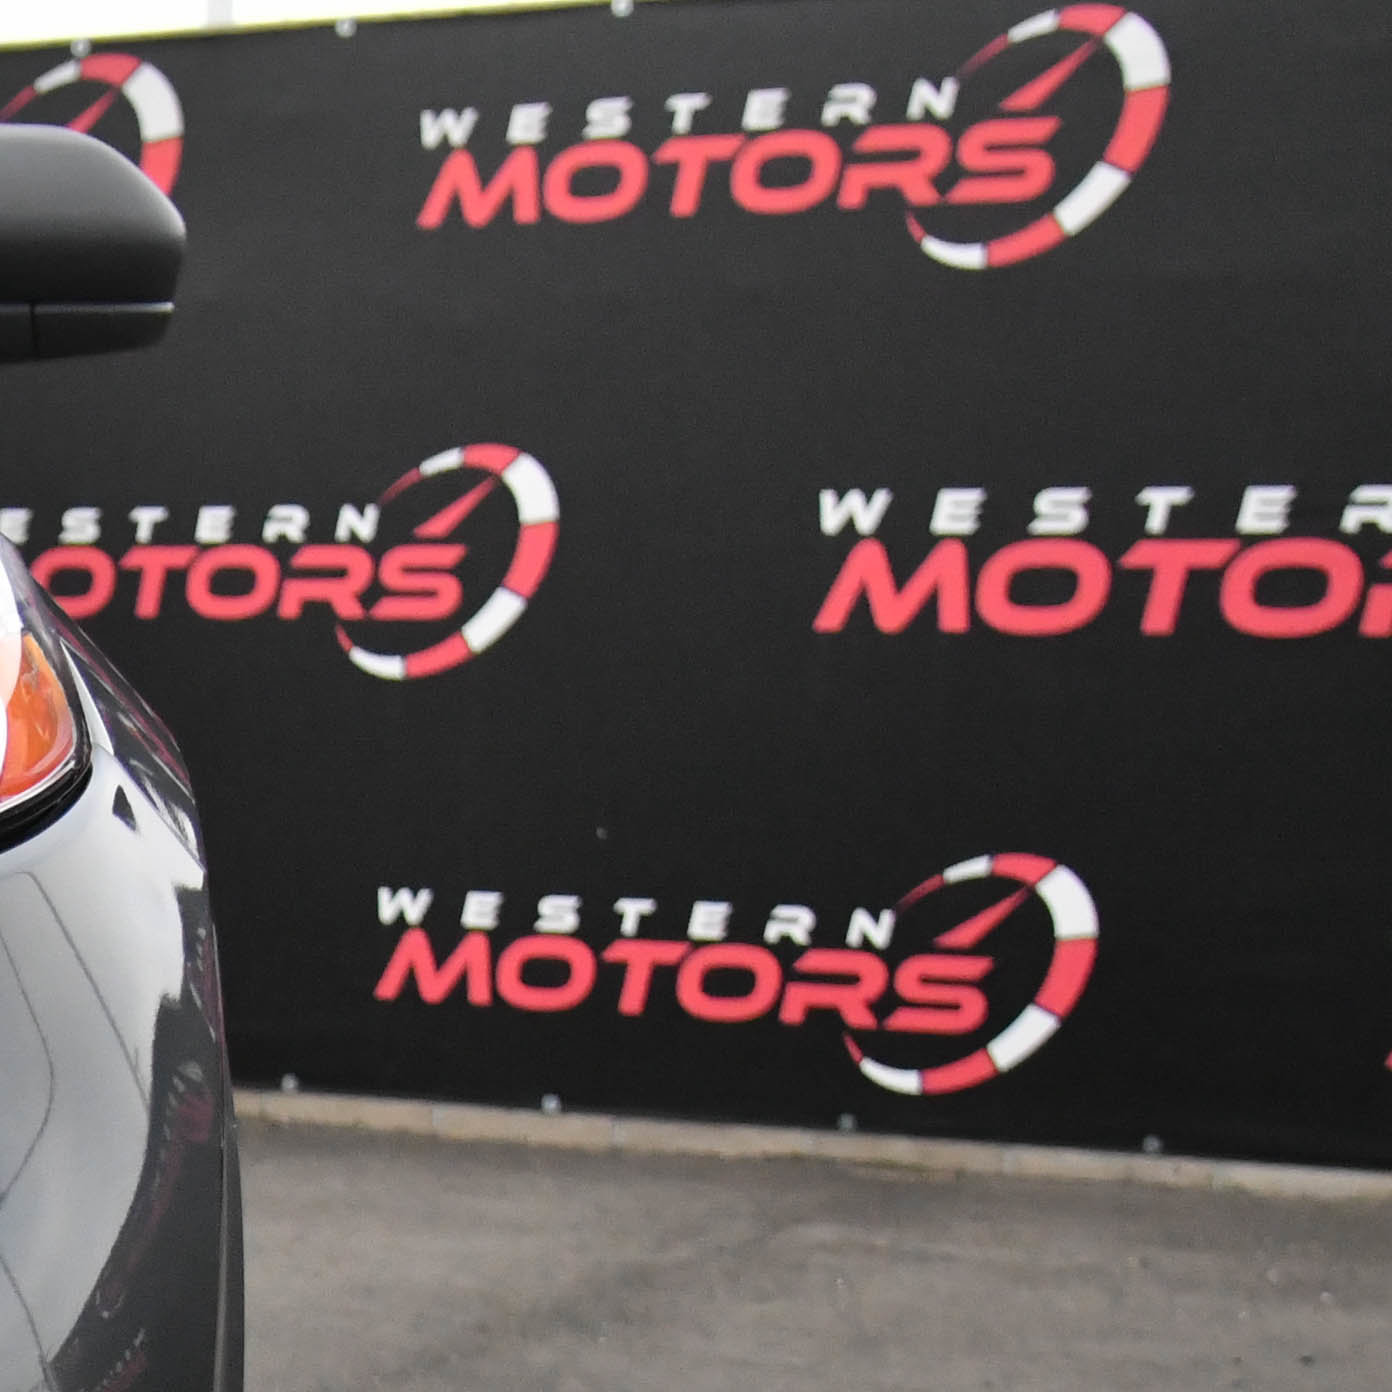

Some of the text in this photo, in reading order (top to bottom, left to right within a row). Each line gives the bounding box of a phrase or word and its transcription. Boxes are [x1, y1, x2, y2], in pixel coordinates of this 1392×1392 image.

[419, 76, 960, 150] WESTERN
[417, 116, 1061, 229] MOTORS
[377, 886, 896, 949] WESTERN
[375, 927, 993, 1035] MOTORS
